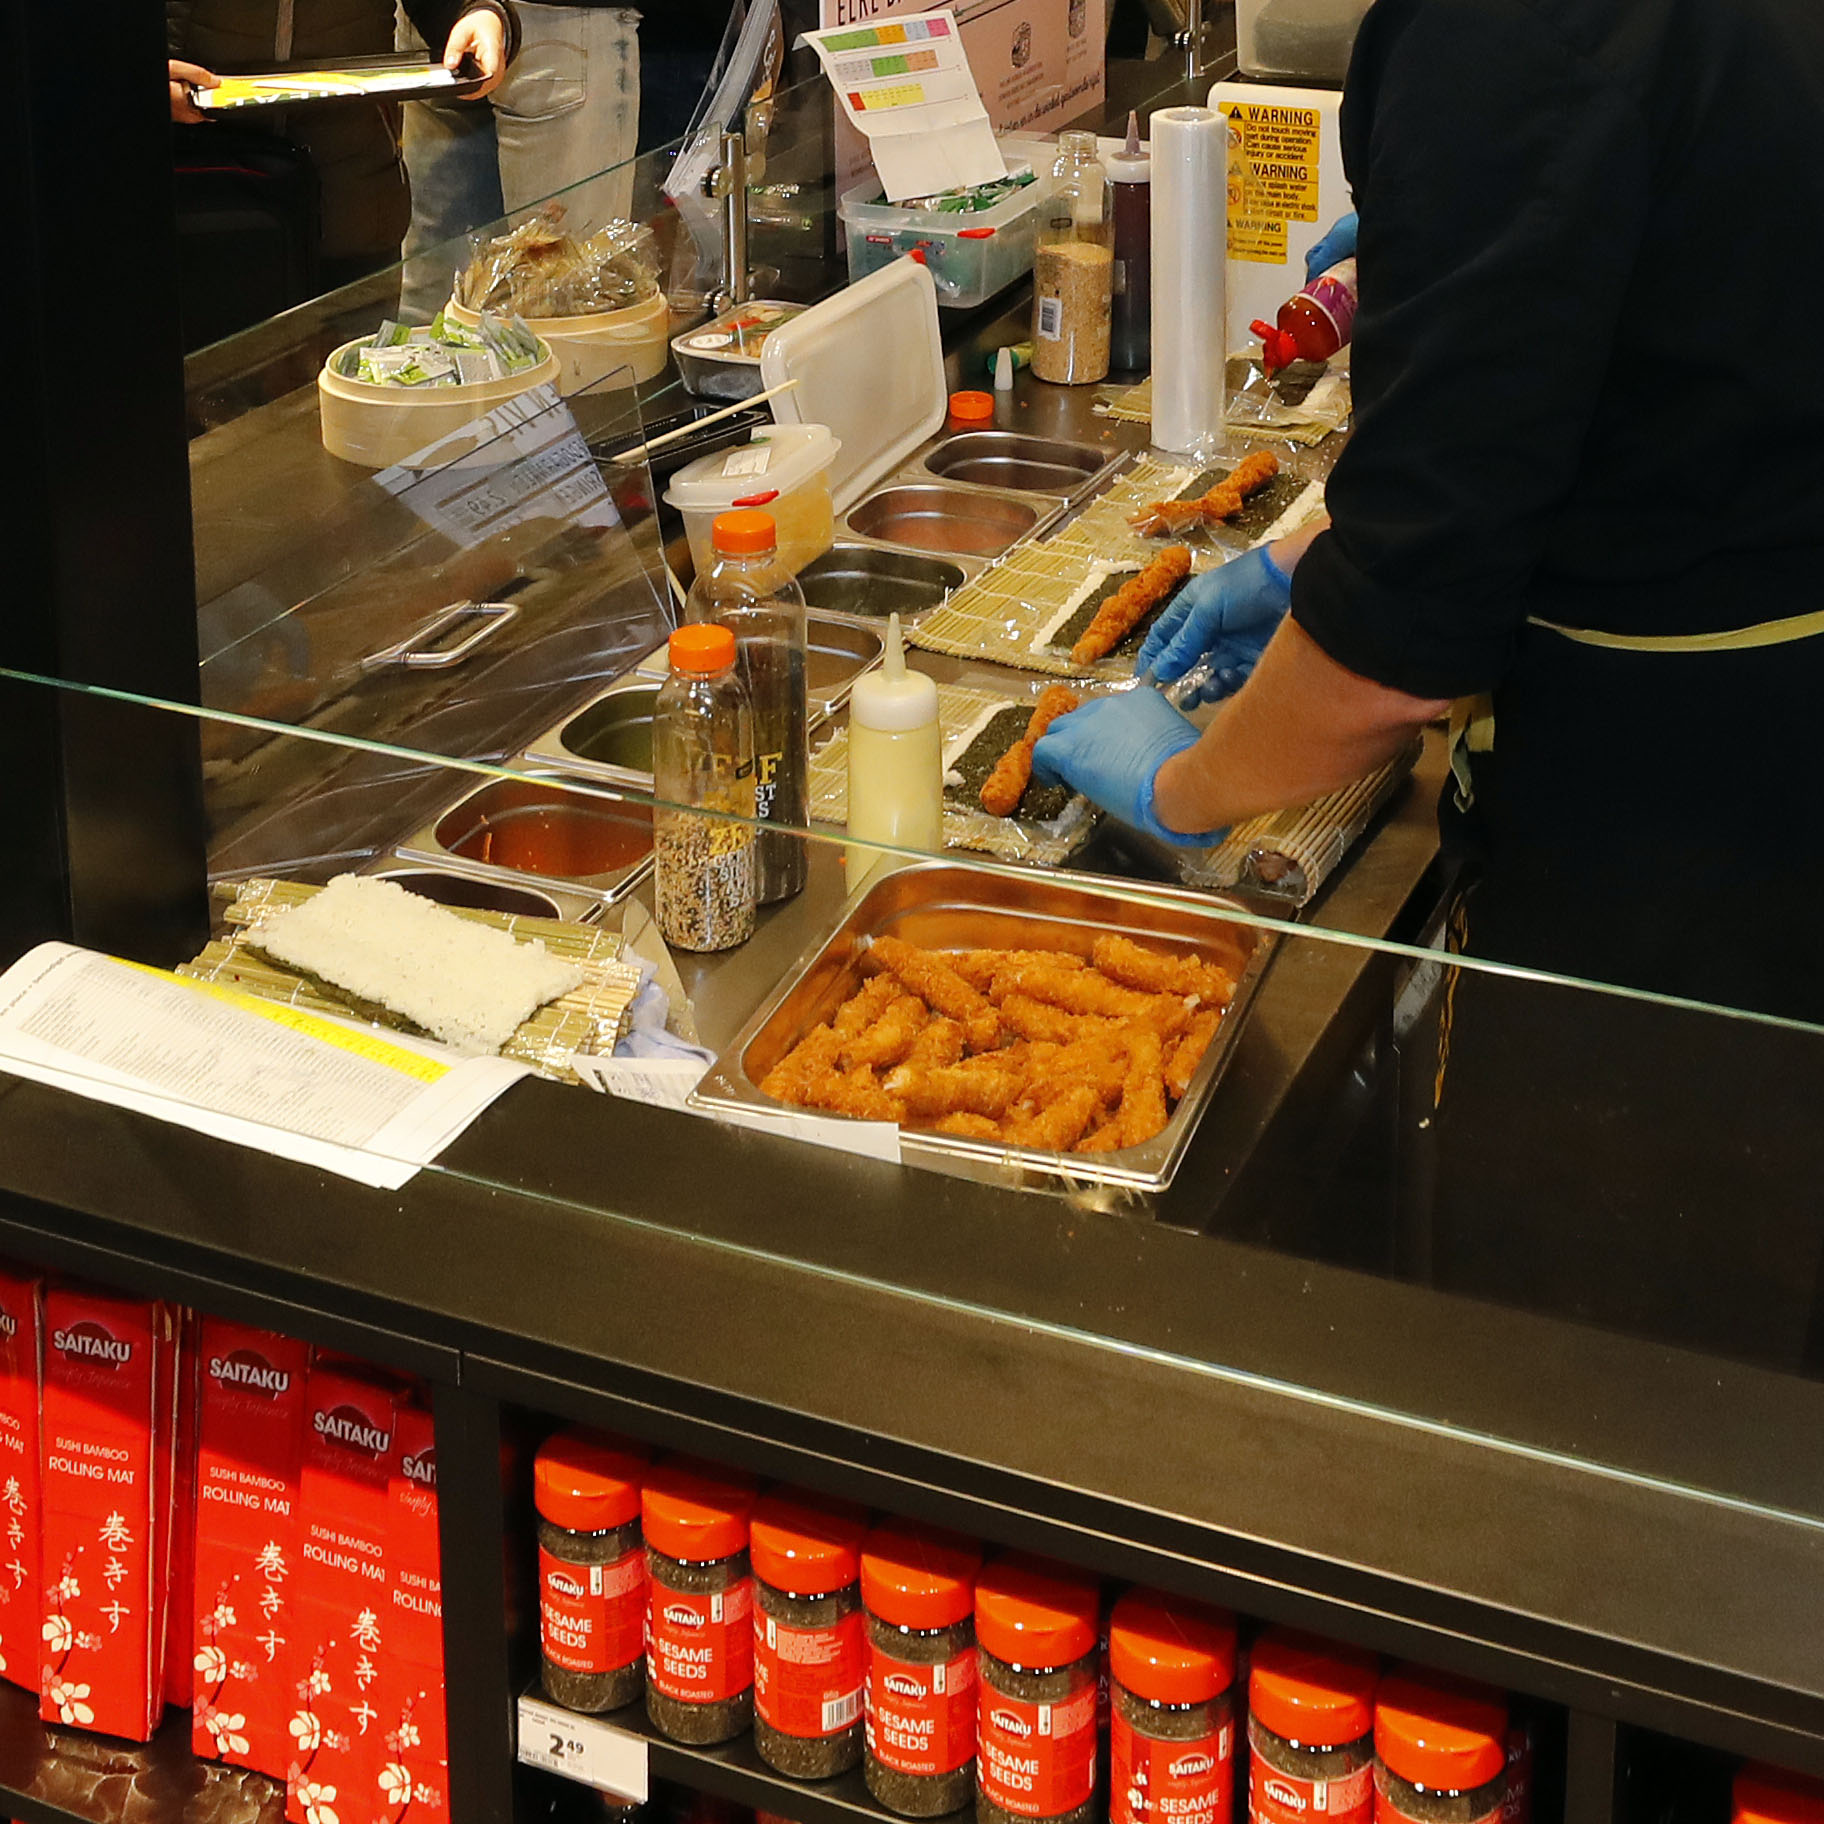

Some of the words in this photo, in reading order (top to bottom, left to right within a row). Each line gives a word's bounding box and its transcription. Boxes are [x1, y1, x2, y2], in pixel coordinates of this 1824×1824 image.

[1248, 106, 1314, 127] WARNING
[1249, 162, 1308, 181] WARNING
[53, 1330, 131, 1363] SAITAKU
[209, 1357, 289, 1392] SAITAKU
[4, 1432, 25, 1455] MAT
[313, 1410, 390, 1453] SAITAKU
[55, 1436, 82, 1453] SUSHI
[82, 1440, 129, 1462] BAMBOO
[48, 1455, 104, 1480] ROLLING
[106, 1468, 136, 1486] MAT
[209, 1465, 238, 1482] SUSHI
[238, 1471, 286, 1493] BAMBOO
[202, 1484, 261, 1510] ROLLING
[1, 1474, 28, 1591] 巻きす
[310, 1524, 337, 1544] SUSHI
[337, 1532, 383, 1559] BAMBOO
[302, 1542, 359, 1573] ROLLING
[97, 1509, 135, 1635] 巻きす
[399, 1570, 427, 1589] SUSHI
[547, 1573, 585, 1599] SAITAKU
[254, 1538, 290, 1664] 巻きす
[544, 1603, 593, 1634] SESAME
[663, 1605, 705, 1629] SAITAKU
[548, 1622, 587, 1650] SEEDS
[562, 1656, 594, 1670] ROASTED
[657, 1637, 713, 1664] SESAME
[349, 1606, 382, 1737] 巻きす
[663, 1657, 707, 1680] SEEDS
[680, 1687, 715, 1700] ROASTED
[883, 1676, 927, 1700] SAITAKU
[878, 1706, 935, 1735] SESAME
[990, 1710, 1032, 1739] SAITAKU
[883, 1727, 929, 1752] SEEDS
[901, 1758, 936, 1772] ROASTED
[985, 1740, 1040, 1776] SESAME
[1168, 1756, 1215, 1779] SAITAKU
[989, 1761, 1033, 1792] SEEDS
[1004, 1798, 1040, 1813] ROASTED
[1159, 1789, 1219, 1815] SESAME
[1263, 1779, 1307, 1813] SAITAKU
